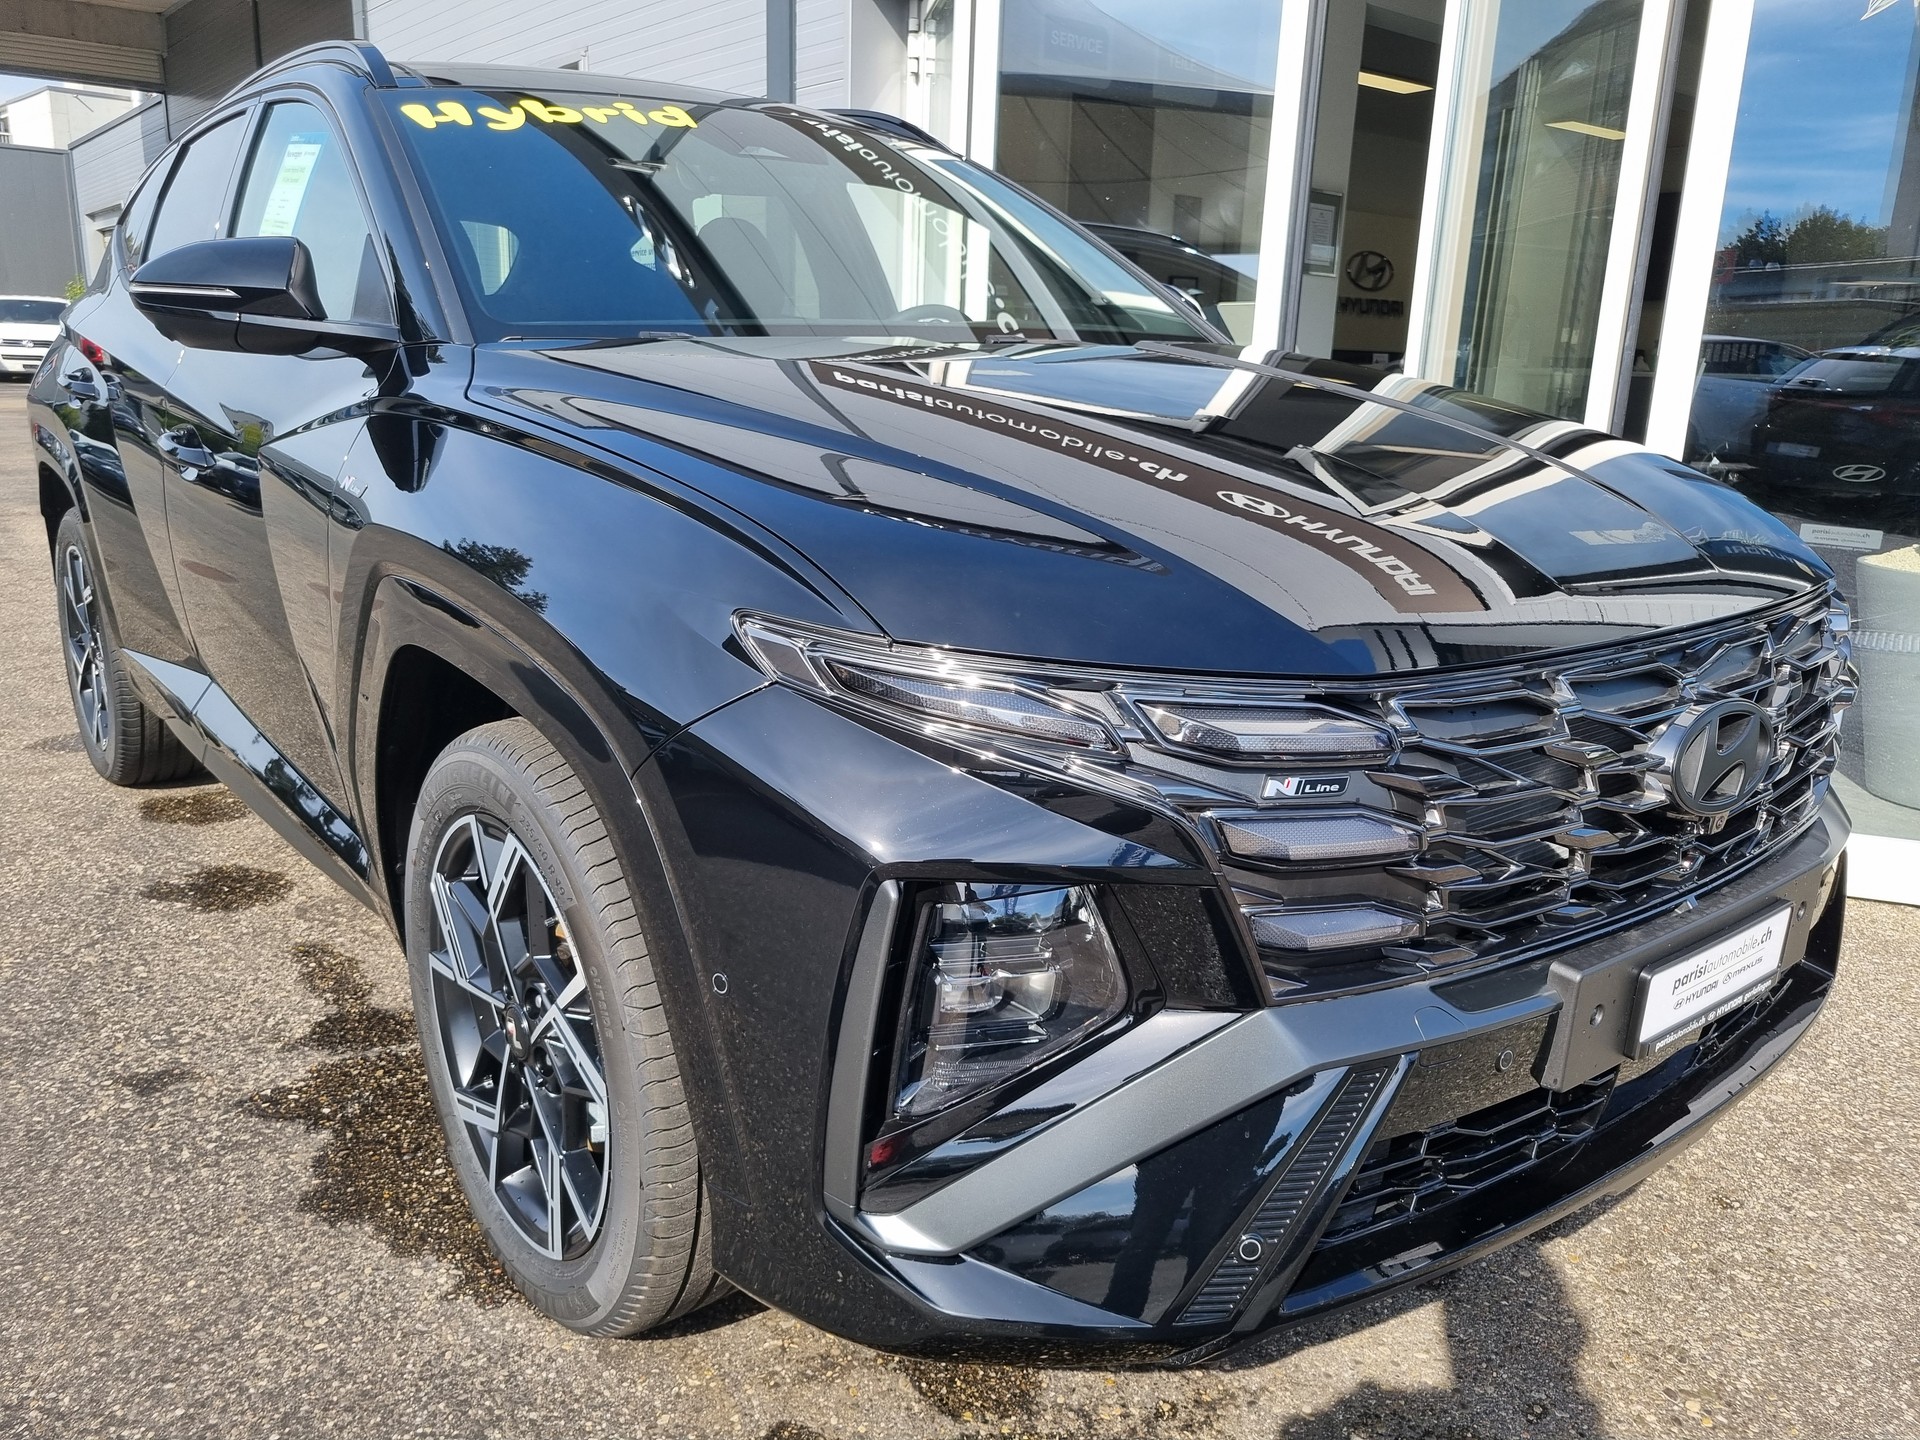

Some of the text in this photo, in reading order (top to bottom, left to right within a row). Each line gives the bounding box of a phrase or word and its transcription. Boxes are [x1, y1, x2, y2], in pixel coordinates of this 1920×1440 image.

[1051, 30, 1103, 54] SERVICE
[1168, 54, 1197, 72] TEILE
[400, 100, 698, 130] Hybrid
[1264, 777, 1340, 797] N Line
[1672, 927, 1773, 995] parisiautomobile.ch
[1685, 956, 1764, 1005] HYUNDAI MAXUS
[1655, 1015, 1706, 1052] parisiautomobile.ch
[1716, 994, 1744, 1017] HYUNDAI
